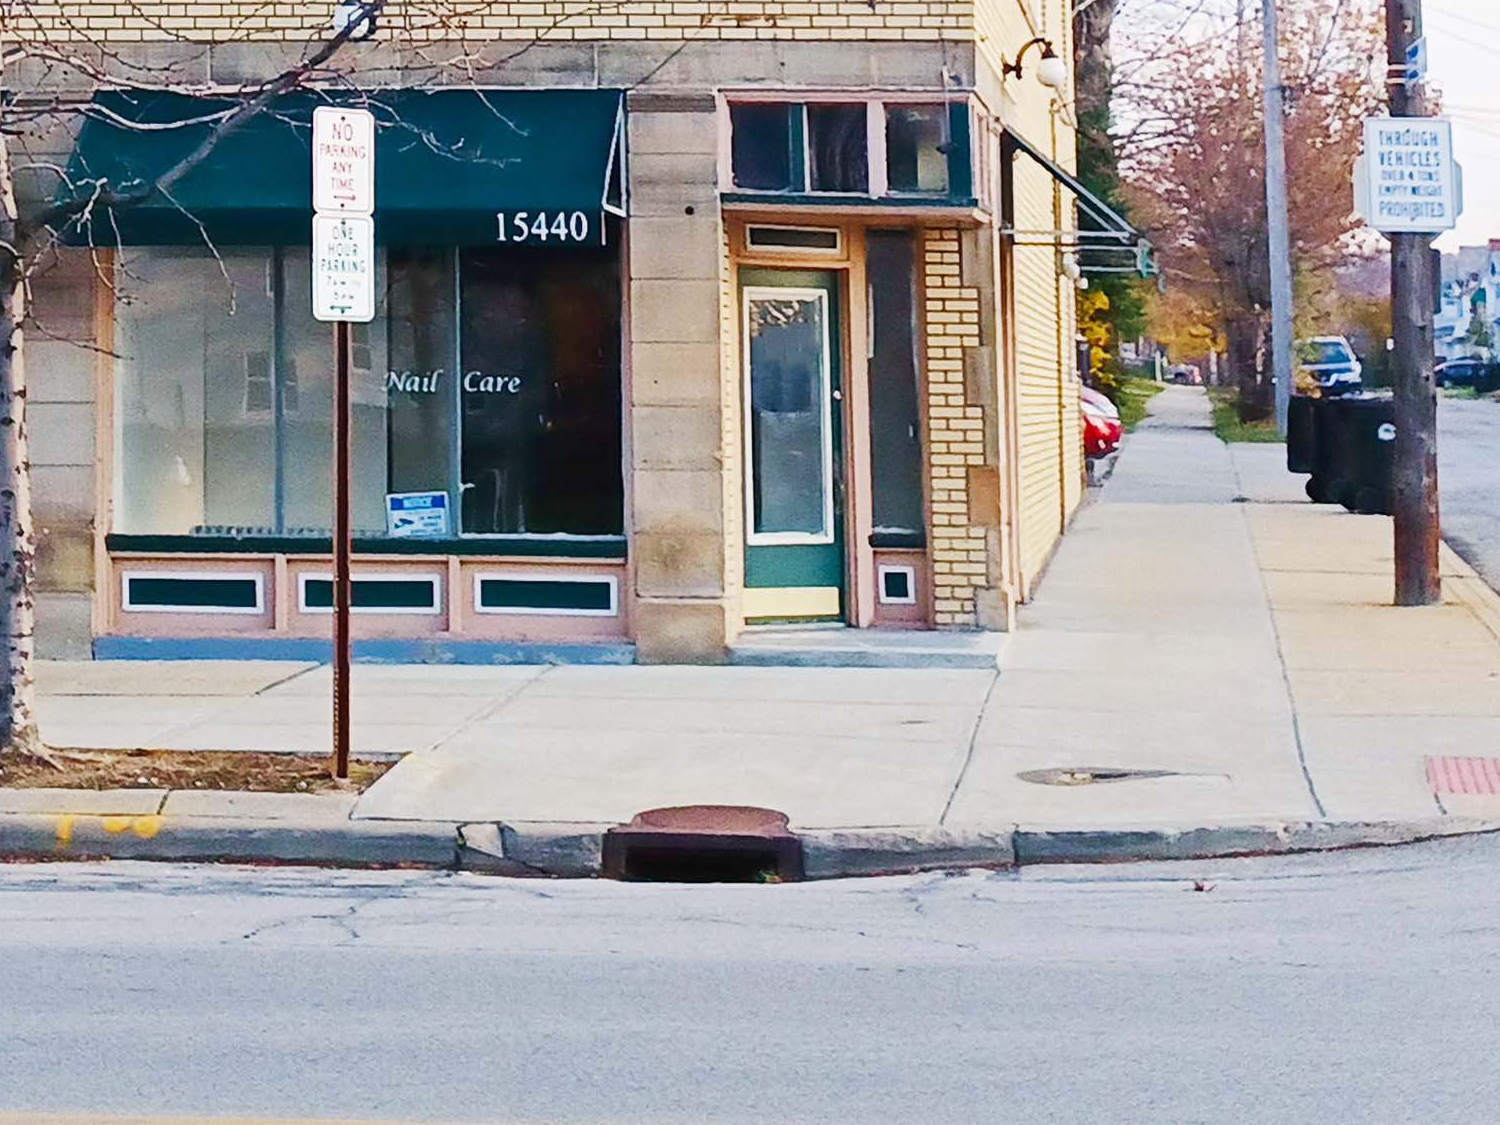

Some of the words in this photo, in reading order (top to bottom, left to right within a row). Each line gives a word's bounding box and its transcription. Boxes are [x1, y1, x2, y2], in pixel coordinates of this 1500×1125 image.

[332, 123, 353, 141] NO
[1379, 130, 1439, 146] THROUGH
[320, 143, 366, 159] PARKING
[1378, 151, 1441, 167] VEHICLES
[332, 161, 353, 173] ANY
[331, 177, 354, 191] TIME
[1379, 201, 1445, 218] PROHIBITED
[332, 225, 353, 241] ONE
[496, 211, 588, 242] 15440
[328, 242, 358, 257] HOUR
[321, 258, 366, 274] PARKING
[385, 369, 444, 393] Nail
[463, 371, 521, 394] Care
